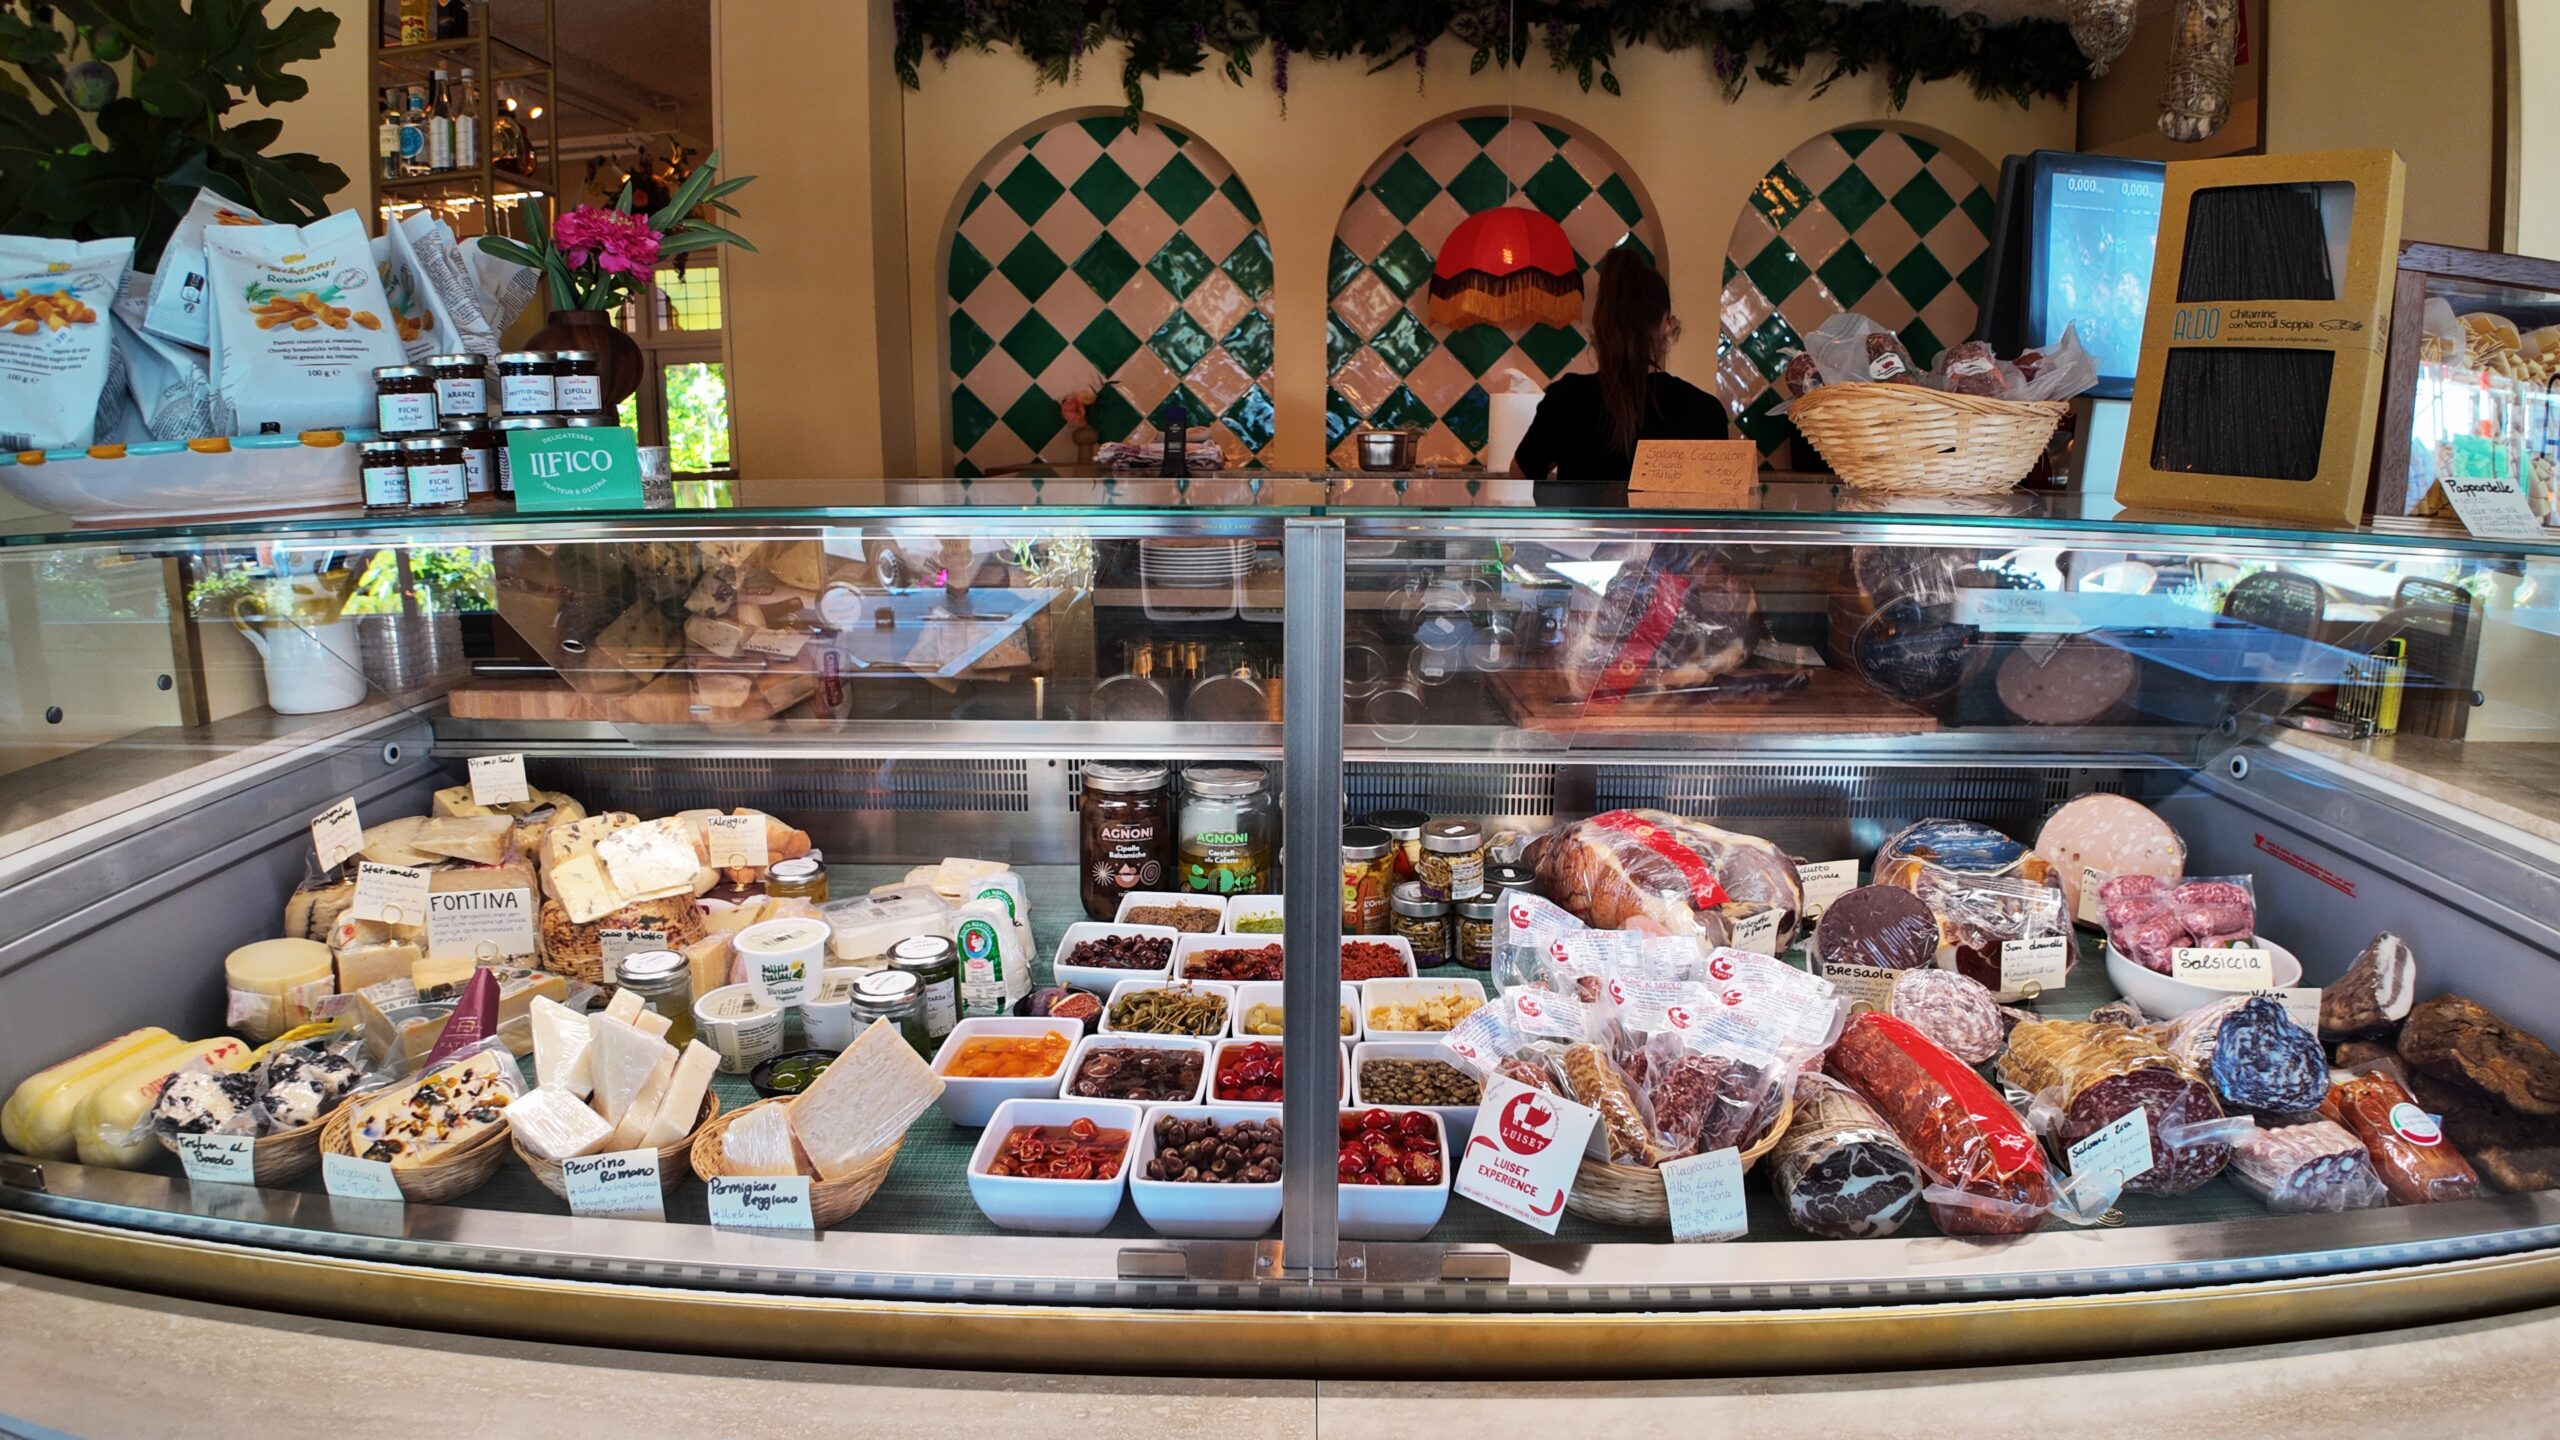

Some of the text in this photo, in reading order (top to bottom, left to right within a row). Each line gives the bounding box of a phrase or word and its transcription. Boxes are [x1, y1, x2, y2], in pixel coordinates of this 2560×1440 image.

[2068, 178, 2097, 193] 0,000
[2121, 182, 2149, 197] 0,000
[2229, 308, 2278, 319] Chitarrine
[2243, 318, 2268, 329] Nero
[2268, 318, 2279, 329] di
[2279, 319, 2315, 332] Seppia
[447, 391, 476, 399] ARANCE
[542, 432, 595, 445] DELICATESSEN
[1646, 447, 1685, 460] Salame
[429, 478, 450, 486] FICHI
[2445, 480, 2515, 498] Pappardelle
[1101, 827, 1153, 839] AGNONI
[1196, 832, 1248, 844] AGNONI
[1115, 844, 1140, 854] Cipolle
[2178, 949, 2262, 970] Salsiccia
[928, 994, 947, 1002] TARDA
[1502, 1127, 1545, 1150] LUISET
[563, 1157, 626, 1176] Pecorino
[1493, 1156, 1531, 1178] LUISET
[600, 1167, 655, 1183] Romano
[1478, 1164, 1539, 1198] EXPERIENCE
[710, 1176, 777, 1198] Parmigiano
